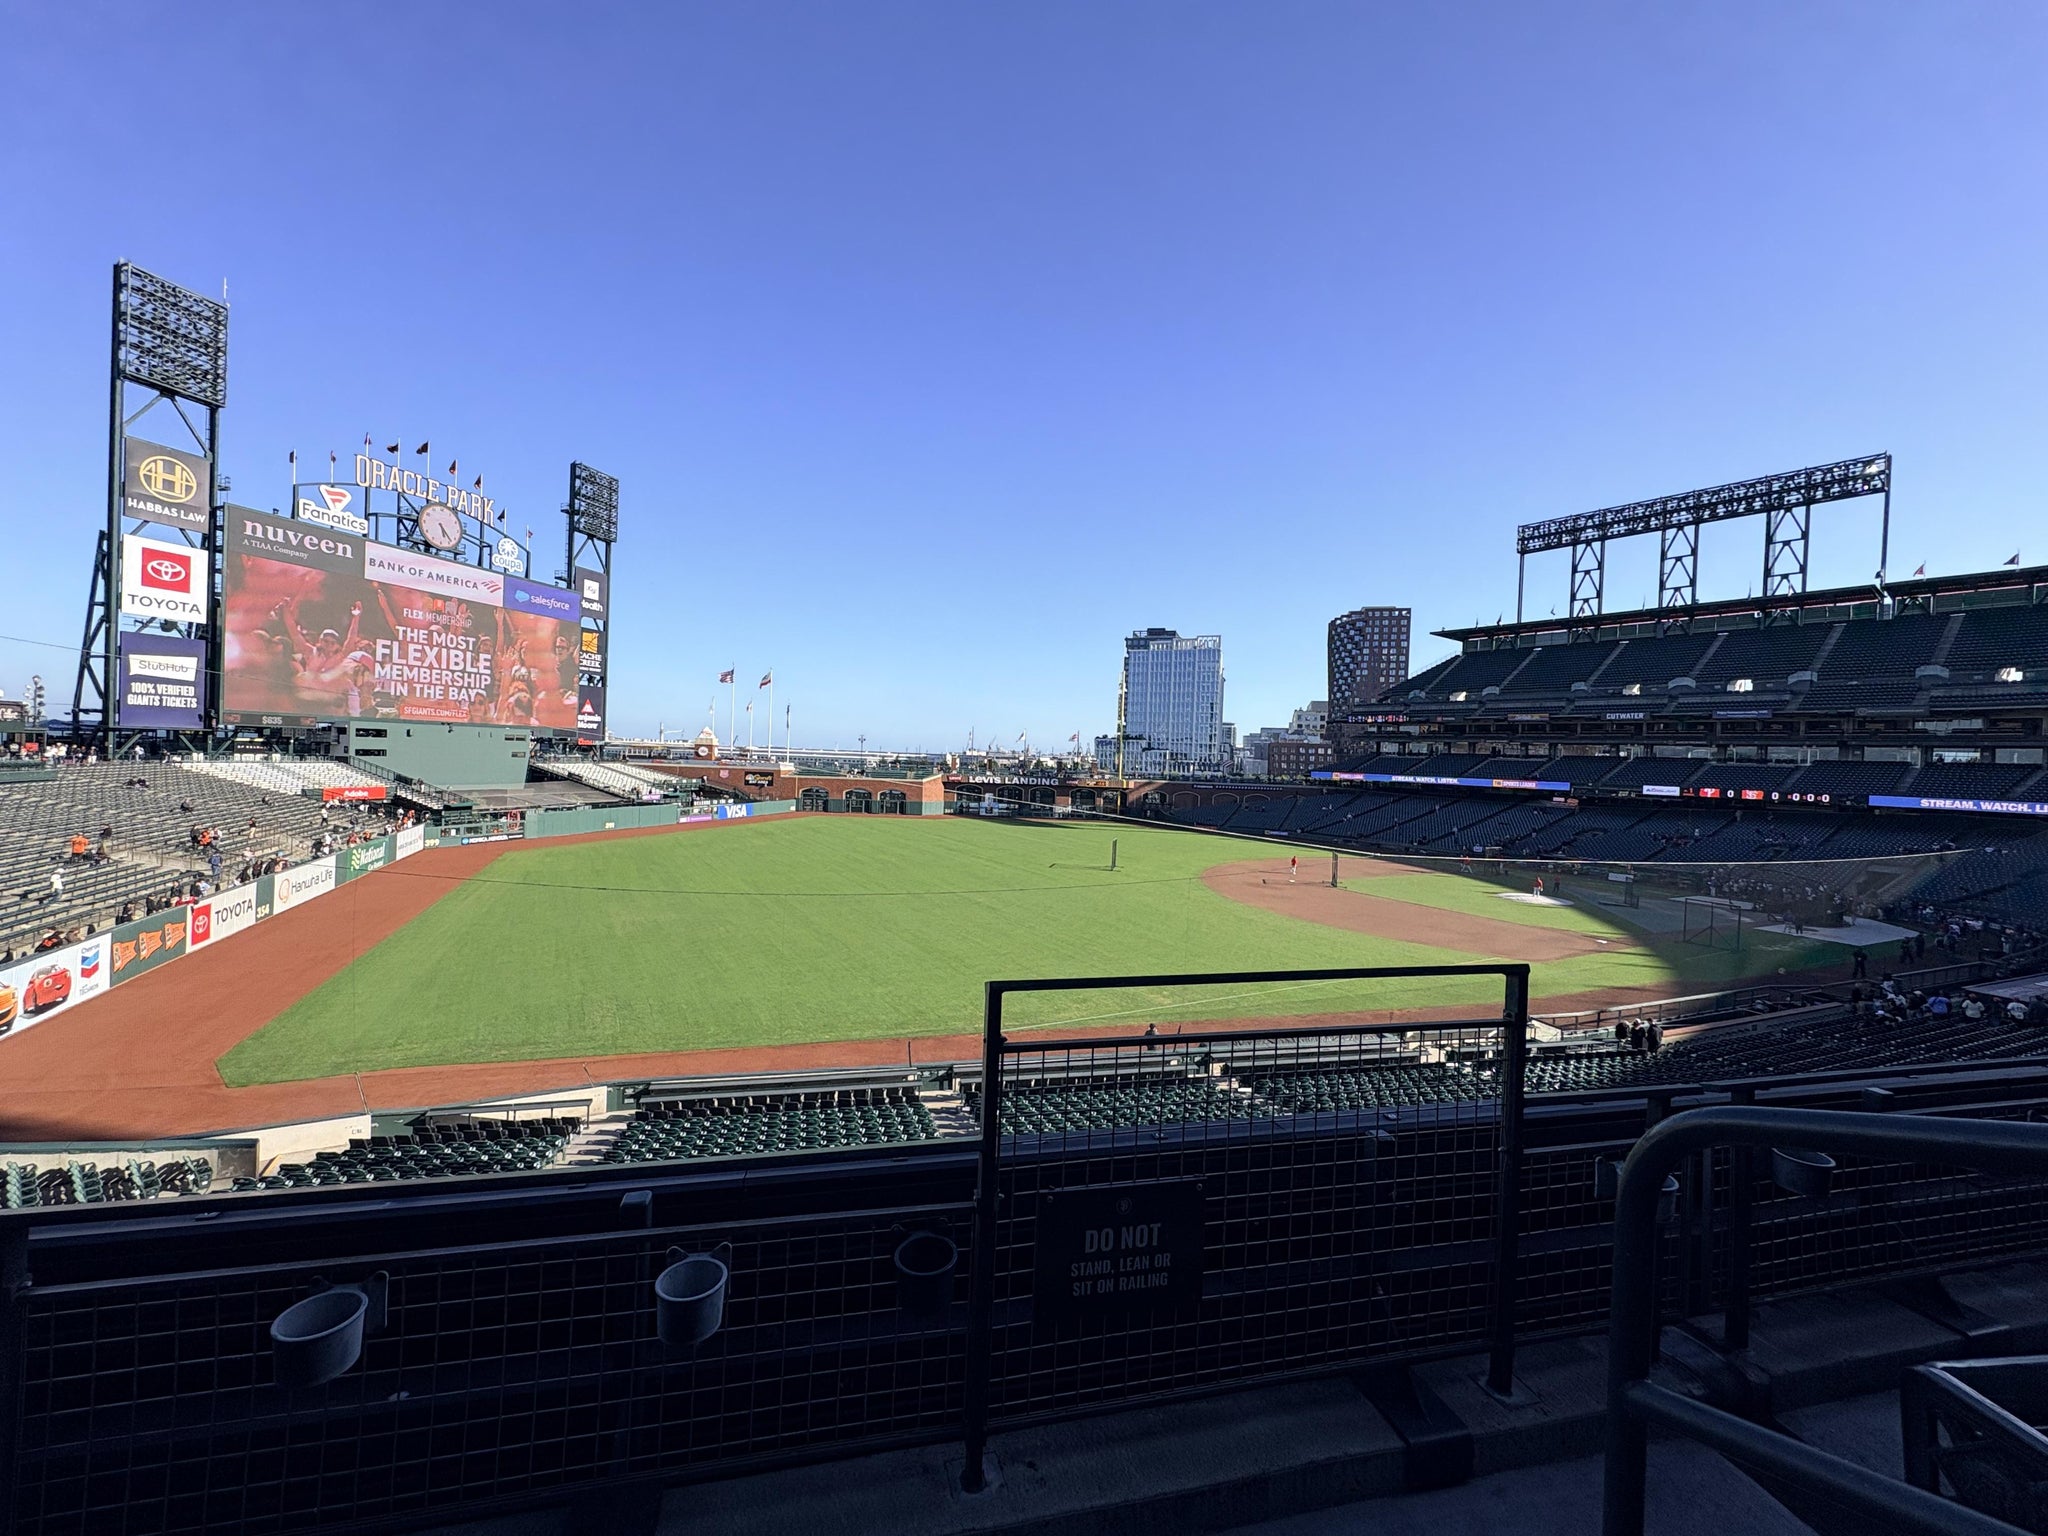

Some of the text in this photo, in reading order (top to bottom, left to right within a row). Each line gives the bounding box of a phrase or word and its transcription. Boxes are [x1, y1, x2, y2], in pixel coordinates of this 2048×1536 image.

[354, 454, 495, 527] ORACLE PARK
[128, 497, 206, 523] HABBAS LAW
[302, 502, 367, 531] Fanatics
[243, 520, 354, 559] nuveen
[273, 545, 309, 560] Company
[494, 556, 522, 572] coupa
[369, 557, 479, 590] BANK OF AMERICA
[127, 594, 202, 615] TOYOTA
[530, 594, 570, 610] salesforce
[403, 607, 472, 628] FLEX MEMBERSHIP
[395, 625, 476, 651] THE MOST
[375, 638, 492, 674] FLEXIBLE
[138, 660, 189, 673] StubHub
[374, 662, 491, 689] MEMBERSHIP
[130, 682, 195, 697] 100% VERIFIED
[390, 681, 478, 702] IN THE BAY
[127, 694, 197, 708] GIANTS TICKETS
[403, 706, 468, 717] SFGIANTS.COM/FLEX
[1606, 712, 1644, 720] CUTWATER
[262, 716, 283, 725] $635
[1005, 776, 1059, 786] LANDING
[343, 789, 369, 797] Adobe
[1727, 789, 1734, 798] 0
[1771, 792, 1779, 800] 0
[1792, 793, 1800, 801] 0
[1807, 793, 1815, 802] 0
[1821, 794, 1830, 803] 0
[724, 804, 747, 818] VISA
[1920, 799, 1977, 809] STREAM.
[1980, 801, 2031, 812] WATCH.
[424, 838, 440, 847] 399
[359, 841, 386, 866] National
[291, 868, 333, 896] Hanwha Life
[215, 898, 253, 925] TOYOTA
[256, 903, 270, 919] 354
[1085, 1222, 1161, 1254] DO NOT
[1070, 1253, 1171, 1277] STAND, LEAN OR
[1072, 1272, 1168, 1297] SIT ON RAILING
